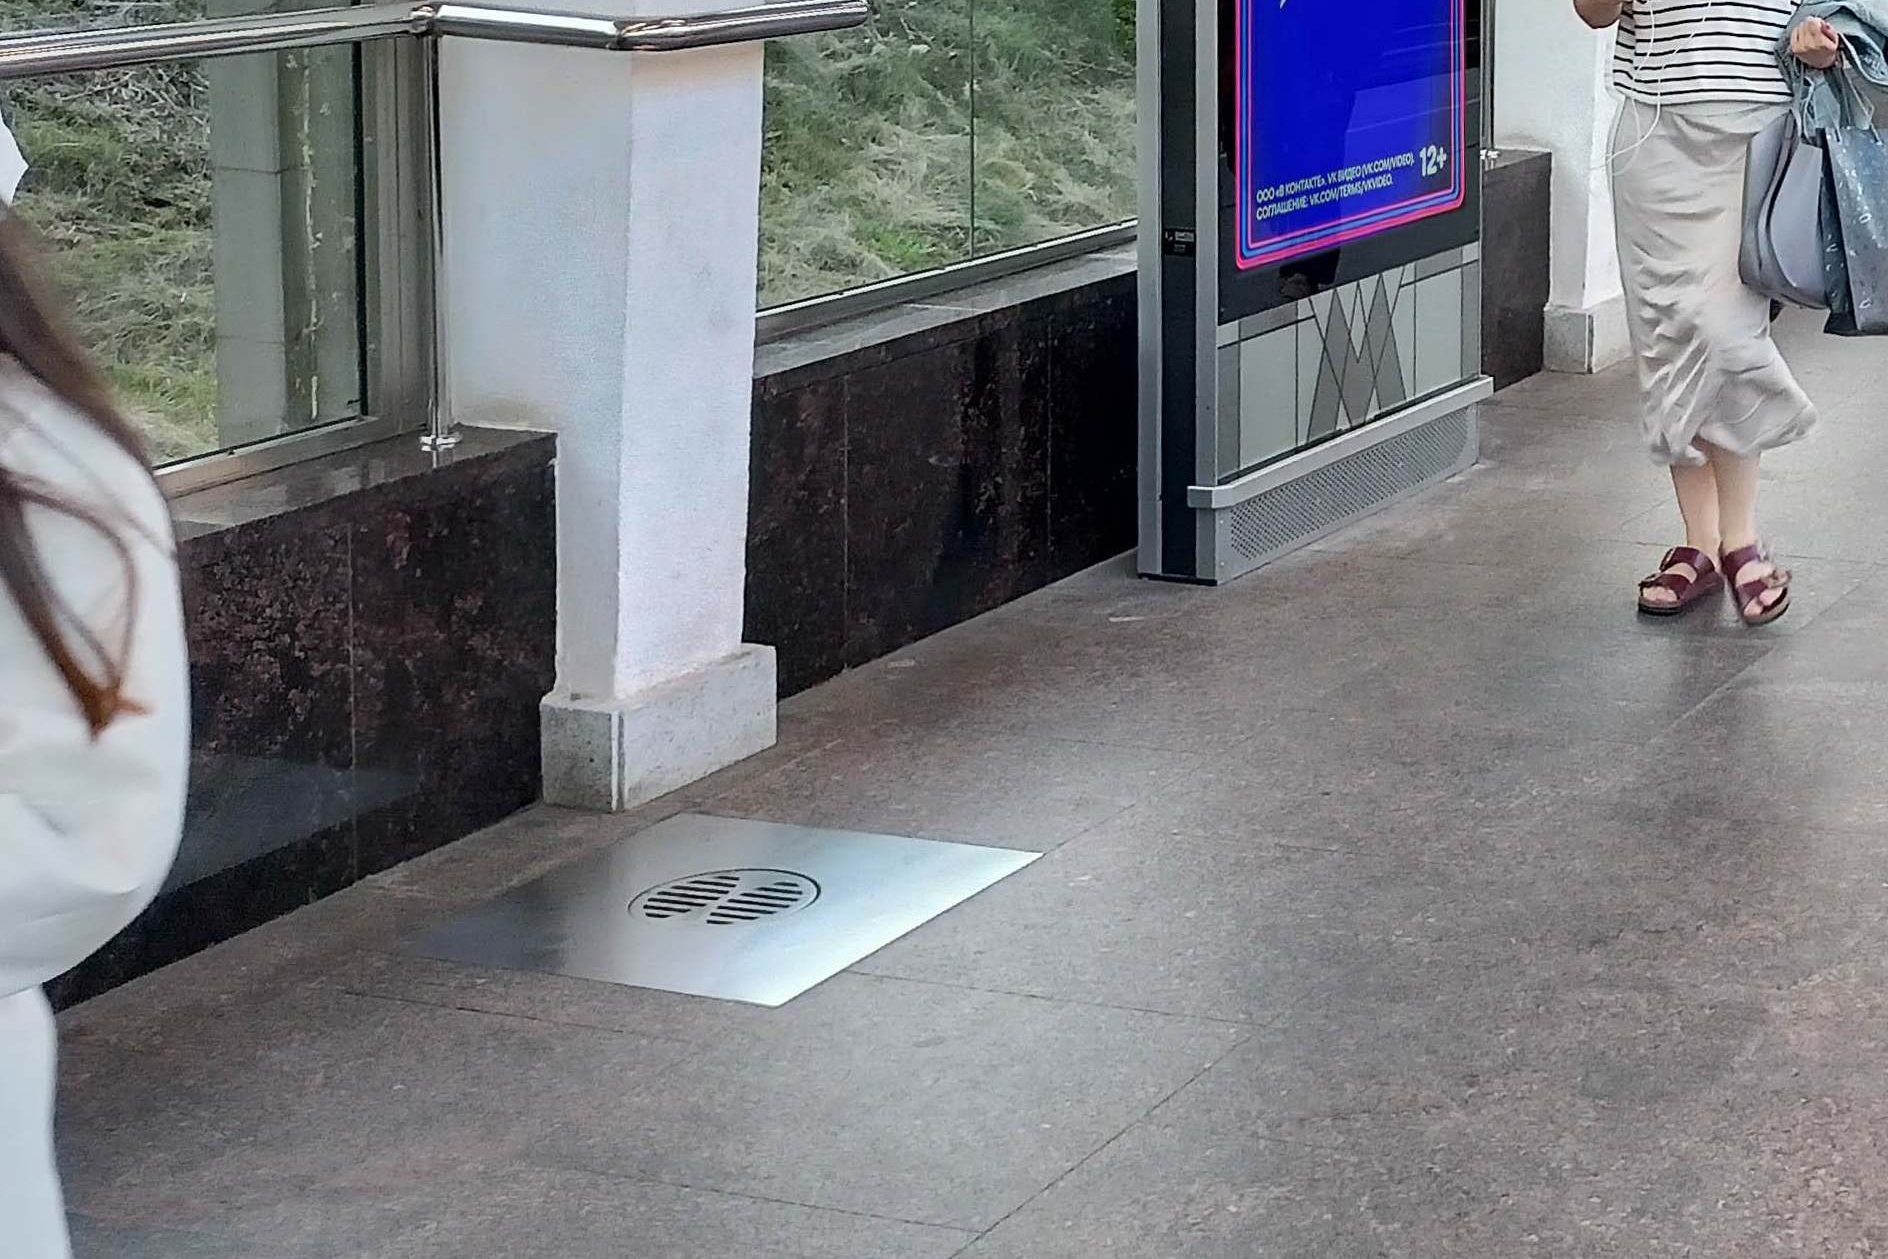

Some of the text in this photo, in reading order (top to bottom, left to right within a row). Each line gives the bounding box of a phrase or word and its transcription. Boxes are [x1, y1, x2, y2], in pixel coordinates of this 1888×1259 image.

[1420, 145, 1447, 177] 12+
[1256, 187, 1275, 203] ООО
[1337, 165, 1361, 183] ВИДЕО
